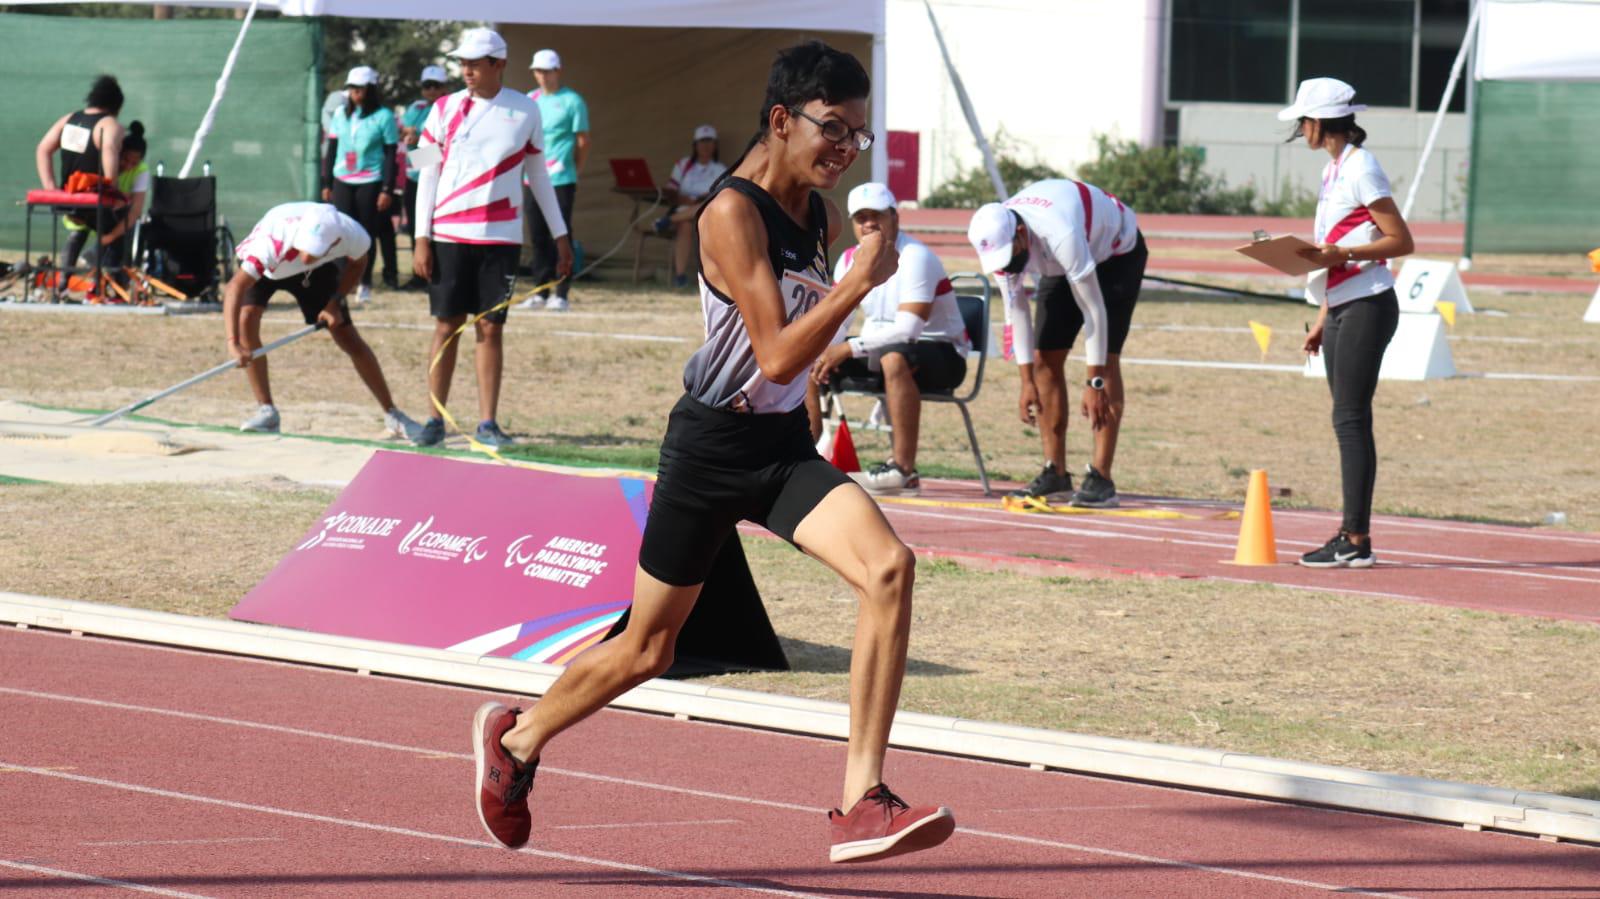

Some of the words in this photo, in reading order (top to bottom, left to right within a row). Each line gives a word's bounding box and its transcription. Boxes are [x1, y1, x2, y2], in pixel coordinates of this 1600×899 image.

[1409, 271, 1429, 300] 6
[336, 515, 402, 537] CONADE
[418, 531, 473, 552] COPAME
[545, 536, 607, 558] AMERICAS
[533, 548, 608, 575] PARALYMPIC
[523, 563, 593, 588] COMMITTEE
